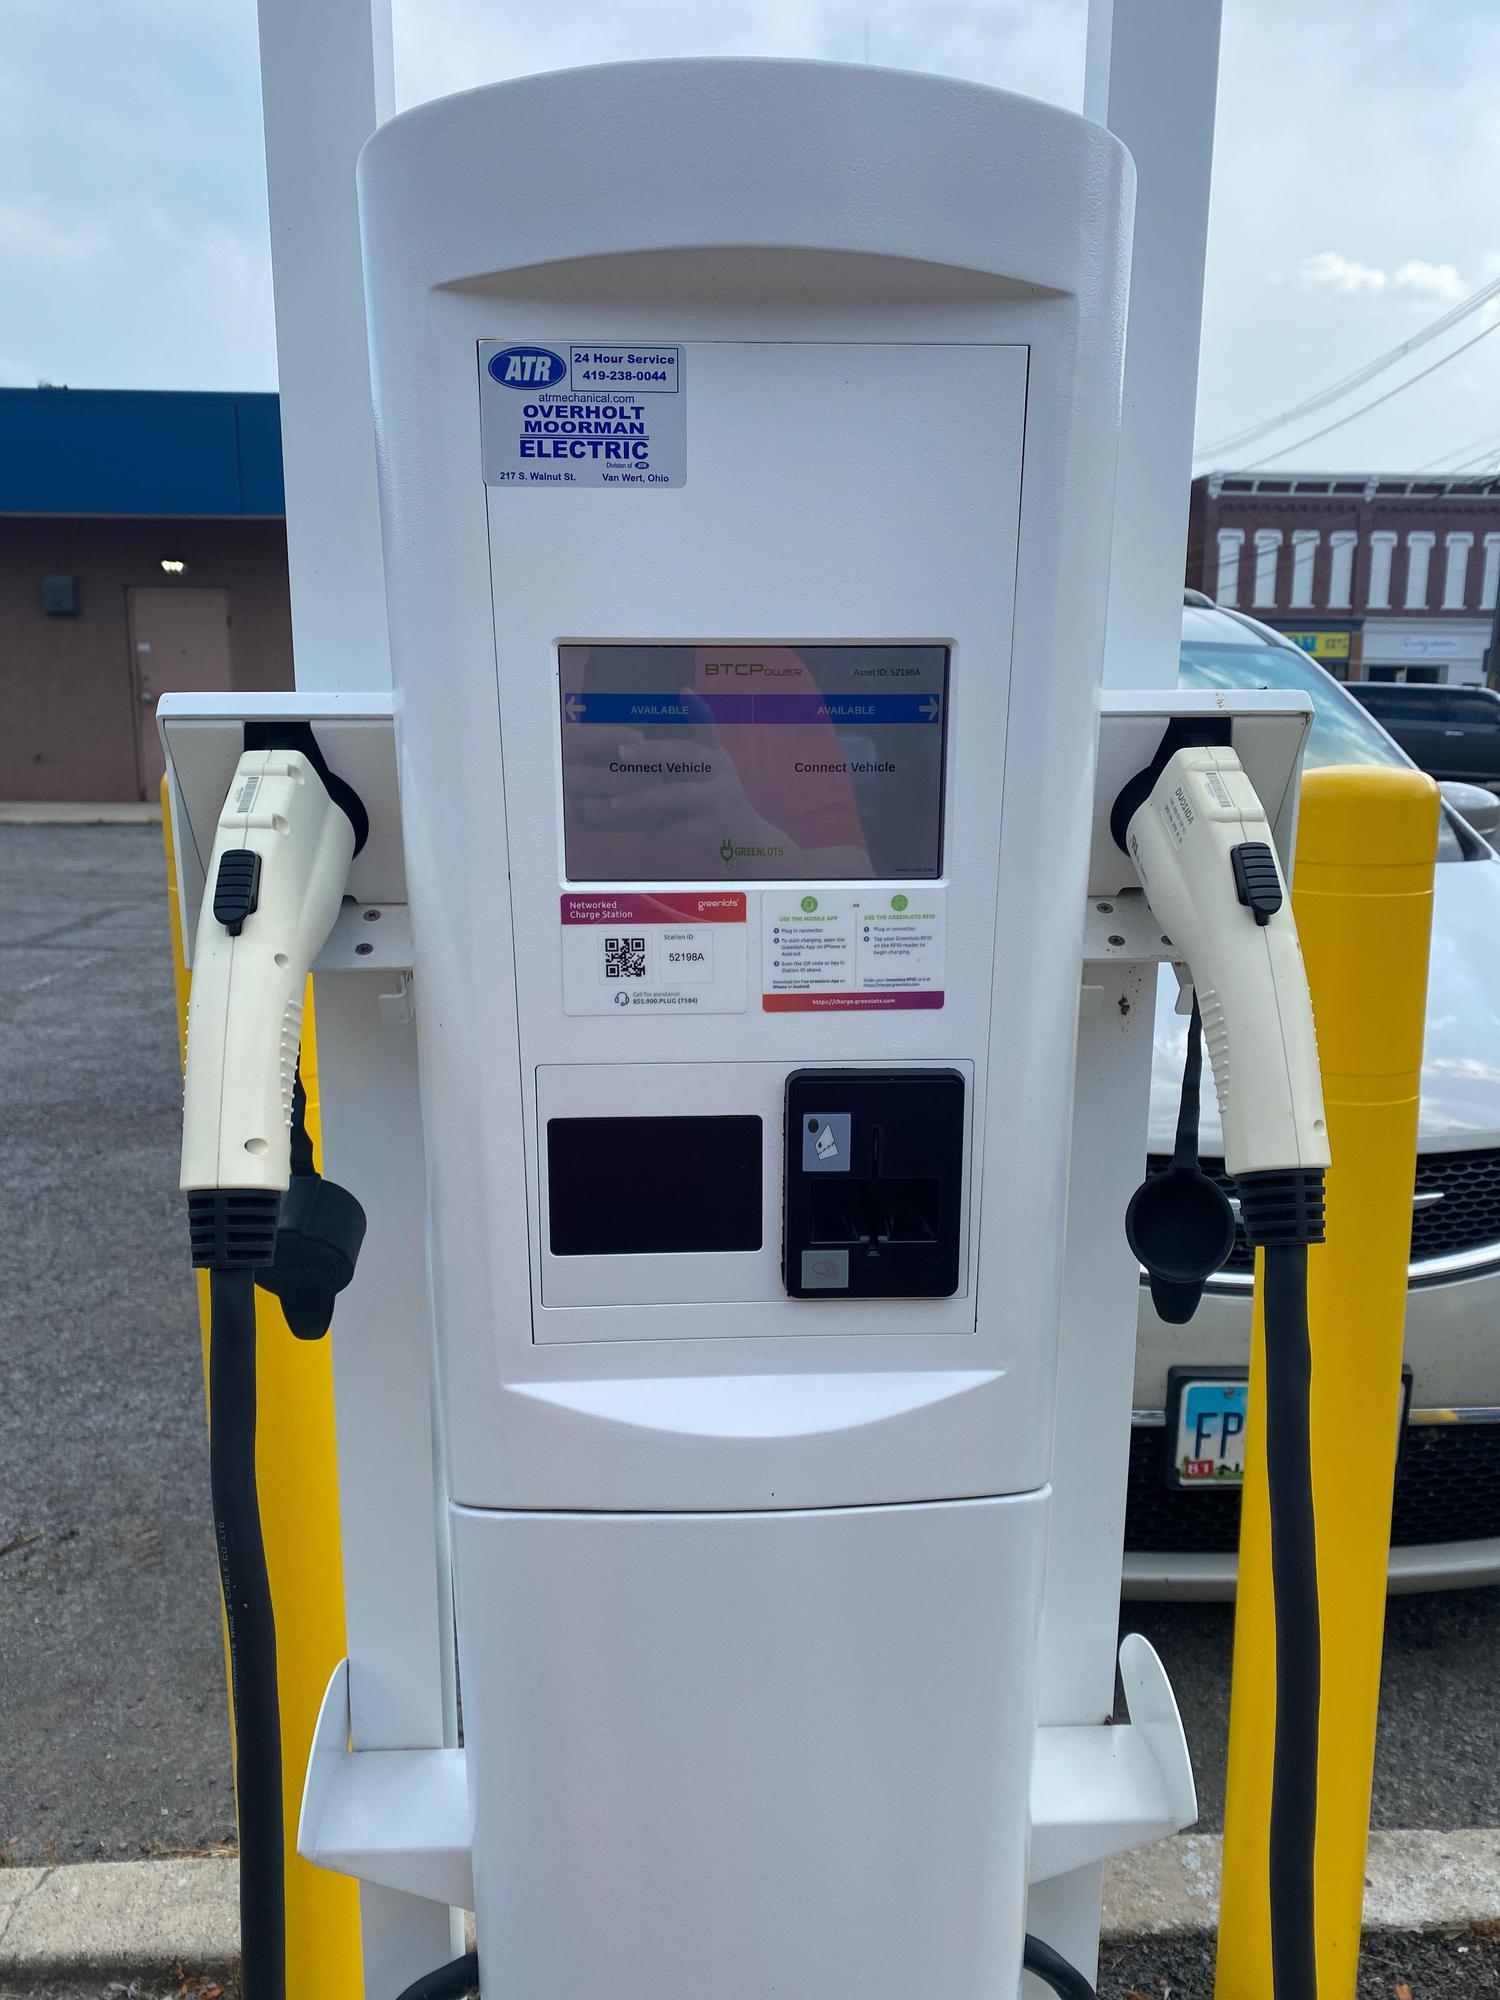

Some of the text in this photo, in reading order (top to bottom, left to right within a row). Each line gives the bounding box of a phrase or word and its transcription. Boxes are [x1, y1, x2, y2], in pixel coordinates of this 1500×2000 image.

[574, 353, 675, 365] 24 Hour Service
[505, 355, 552, 381] ATR
[582, 370, 667, 381] 419-238-0044
[538, 393, 635, 404] atrmechanical.com
[522, 404, 645, 420] OVERHOLT
[524, 420, 645, 435] MOORMAN
[519, 439, 649, 460] ELECTRIC
[499, 472, 576, 482] 217 S. Walnut St.
[602, 473, 670, 483] Van Wert, Ohio
[853, 668, 921, 677] Asset ID: 52198A
[630, 705, 689, 715] AVAILABLE
[817, 705, 876, 715] AVAILABLE
[609, 761, 712, 774] Connect Vehicle
[794, 761, 896, 774] Connect Vehicle
[1175, 787, 1195, 825] DUOSIDA
[734, 846, 785, 858] GREENLOTS
[569, 901, 617, 910] Networked
[697, 899, 739, 911] greenlots
[569, 910, 633, 920] Charge Station
[668, 953, 705, 962] 52198A
[1187, 1463, 1212, 1476] 81
